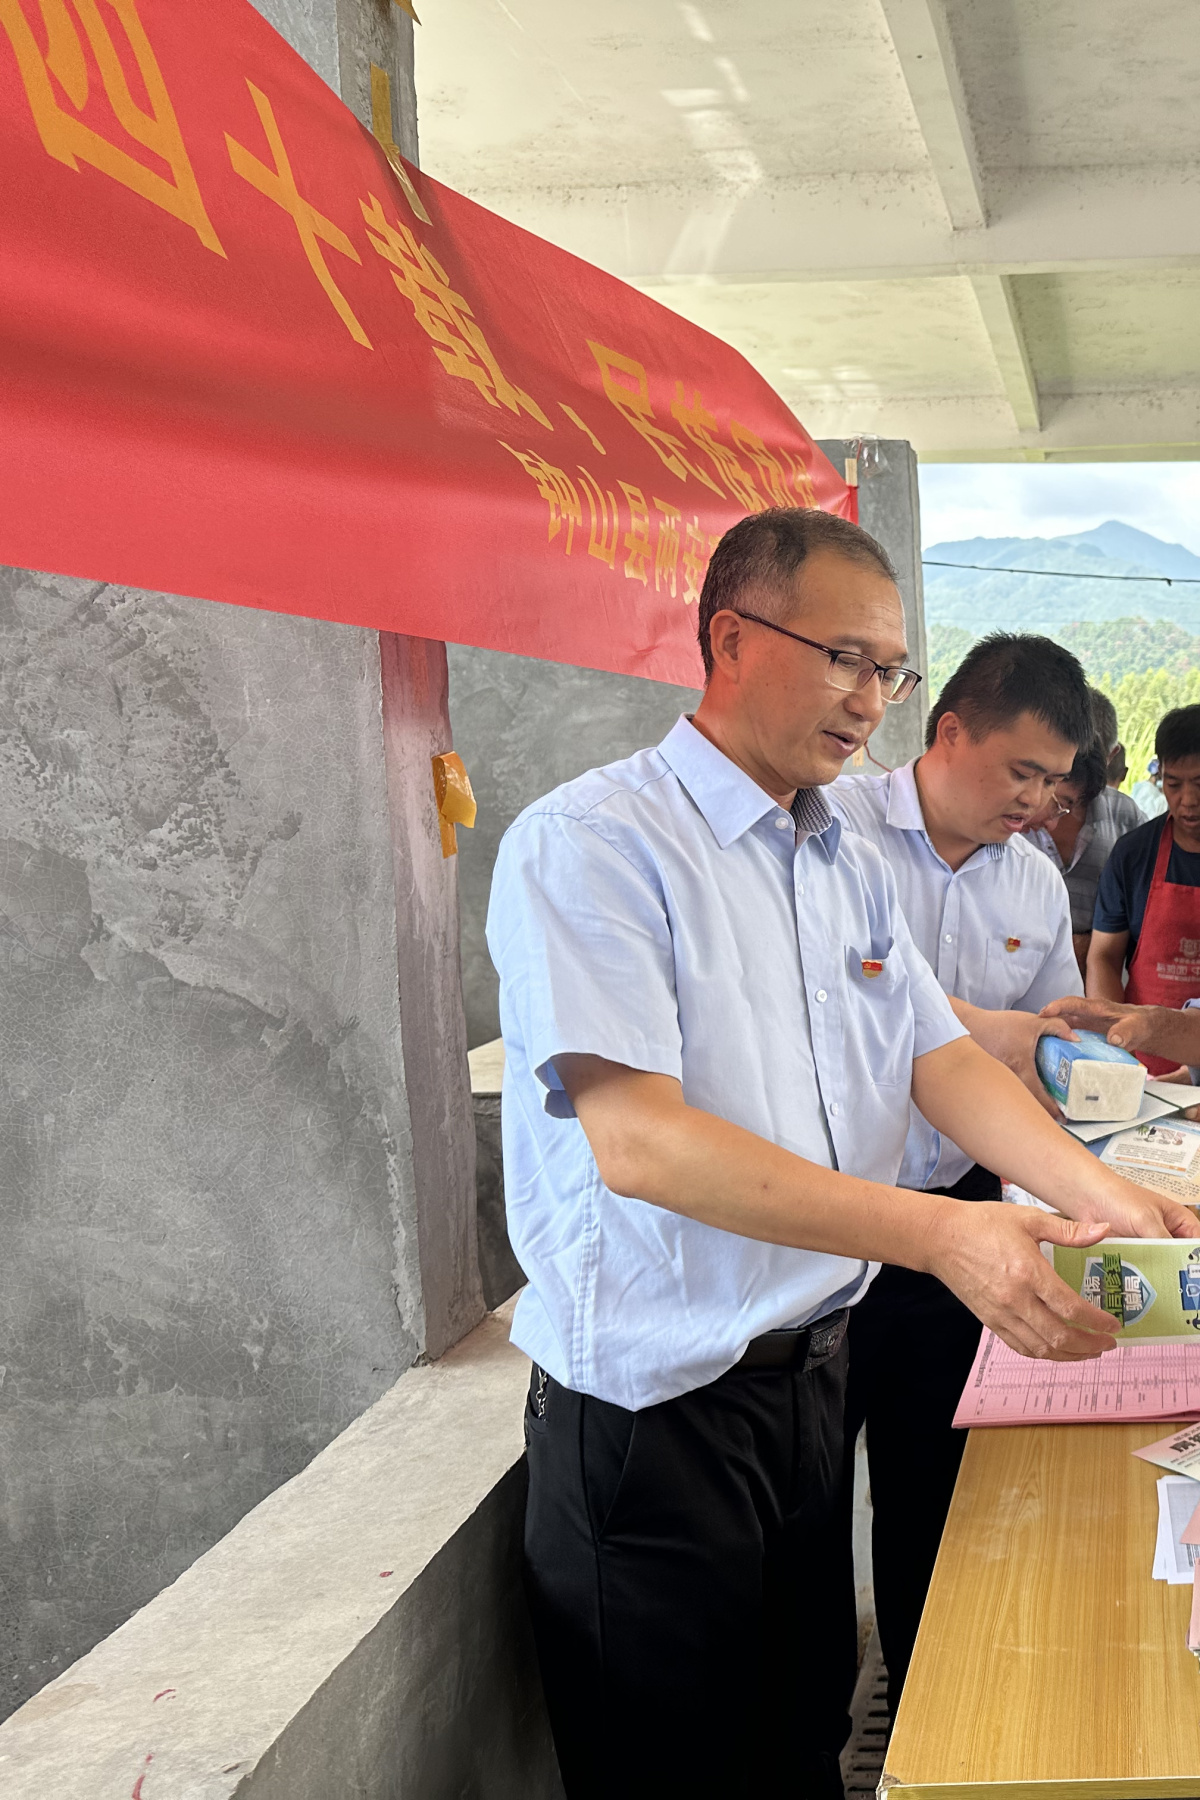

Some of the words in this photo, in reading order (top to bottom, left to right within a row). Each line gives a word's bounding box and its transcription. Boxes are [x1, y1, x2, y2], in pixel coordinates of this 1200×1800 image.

[497, 440, 721, 605] 钟山县两安
[1124, 1275, 1143, 1311] 骗局
